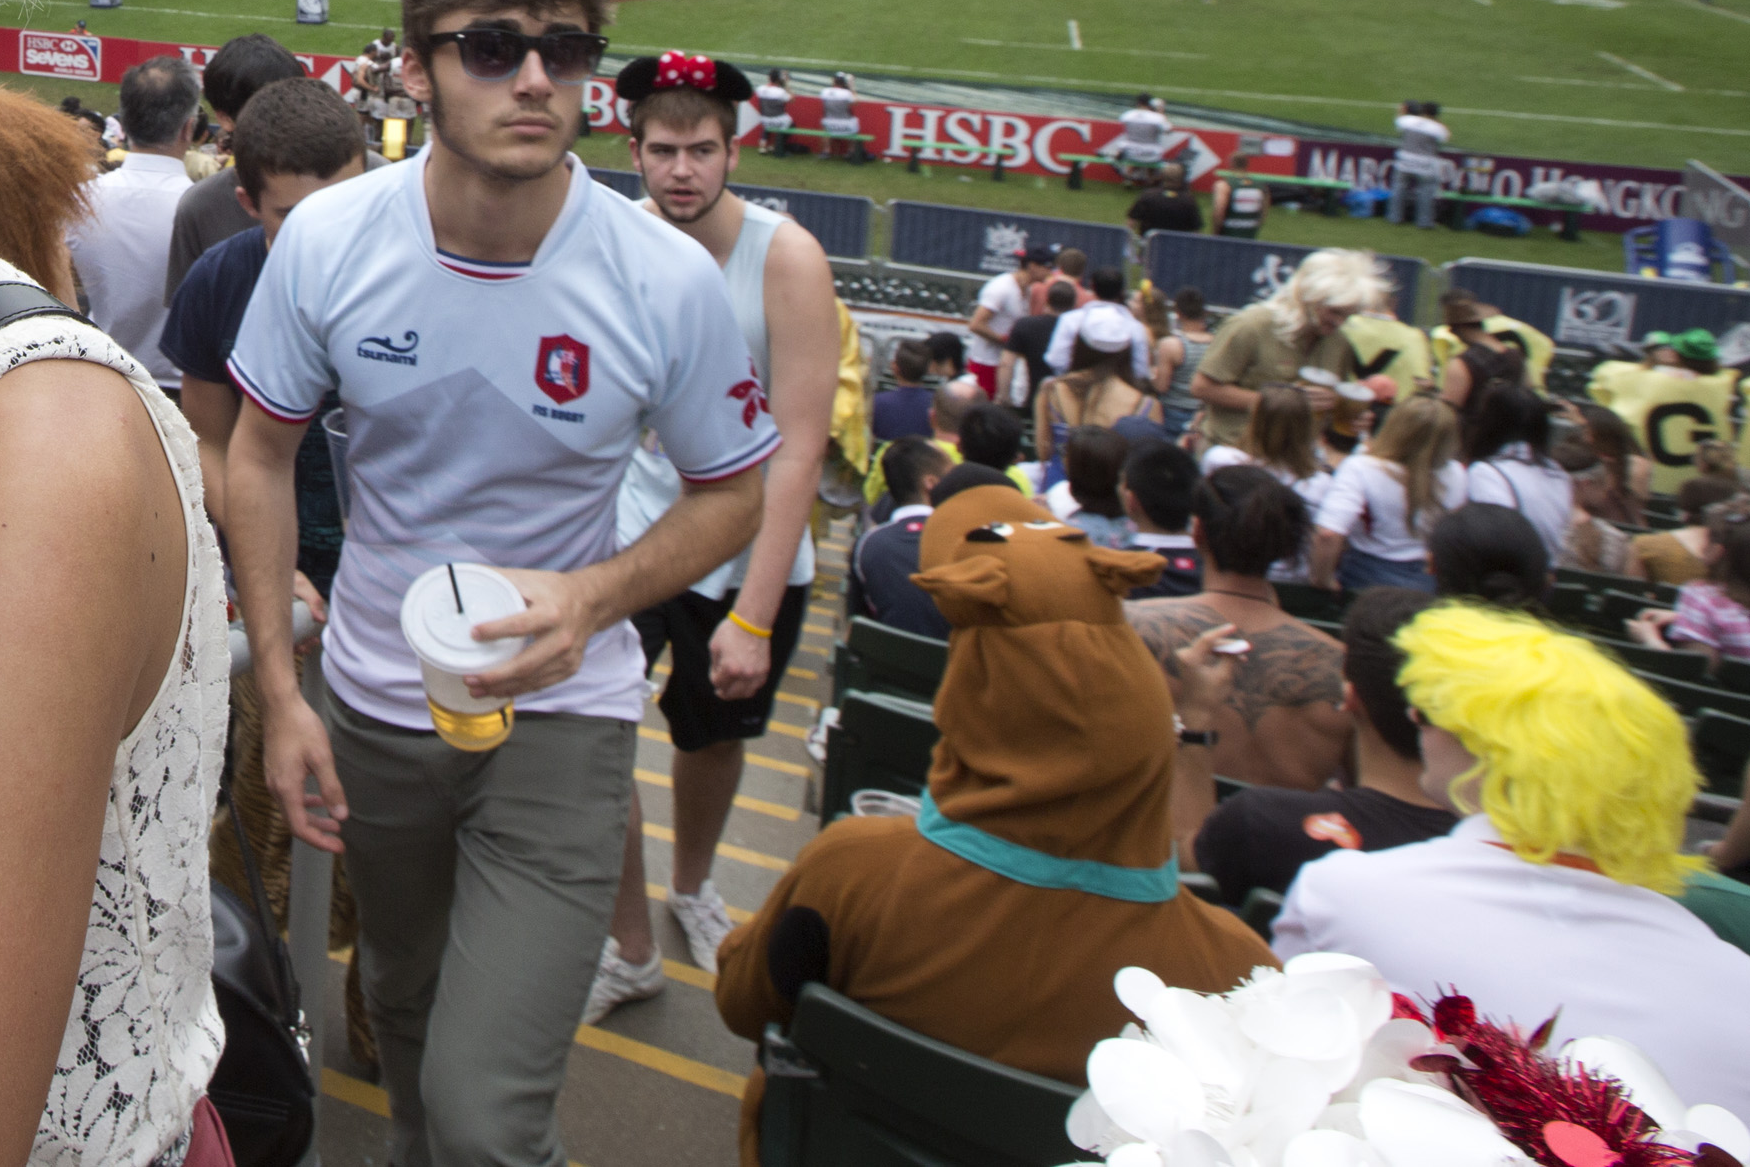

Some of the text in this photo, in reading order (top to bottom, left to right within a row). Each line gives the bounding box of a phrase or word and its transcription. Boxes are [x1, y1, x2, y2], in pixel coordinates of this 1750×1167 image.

[26, 37, 58, 50] HSBC
[885, 105, 1093, 174] HSBC
[357, 346, 418, 367] tsunami
[552, 409, 585, 423] RUGBY
[1648, 403, 1717, 466] G
